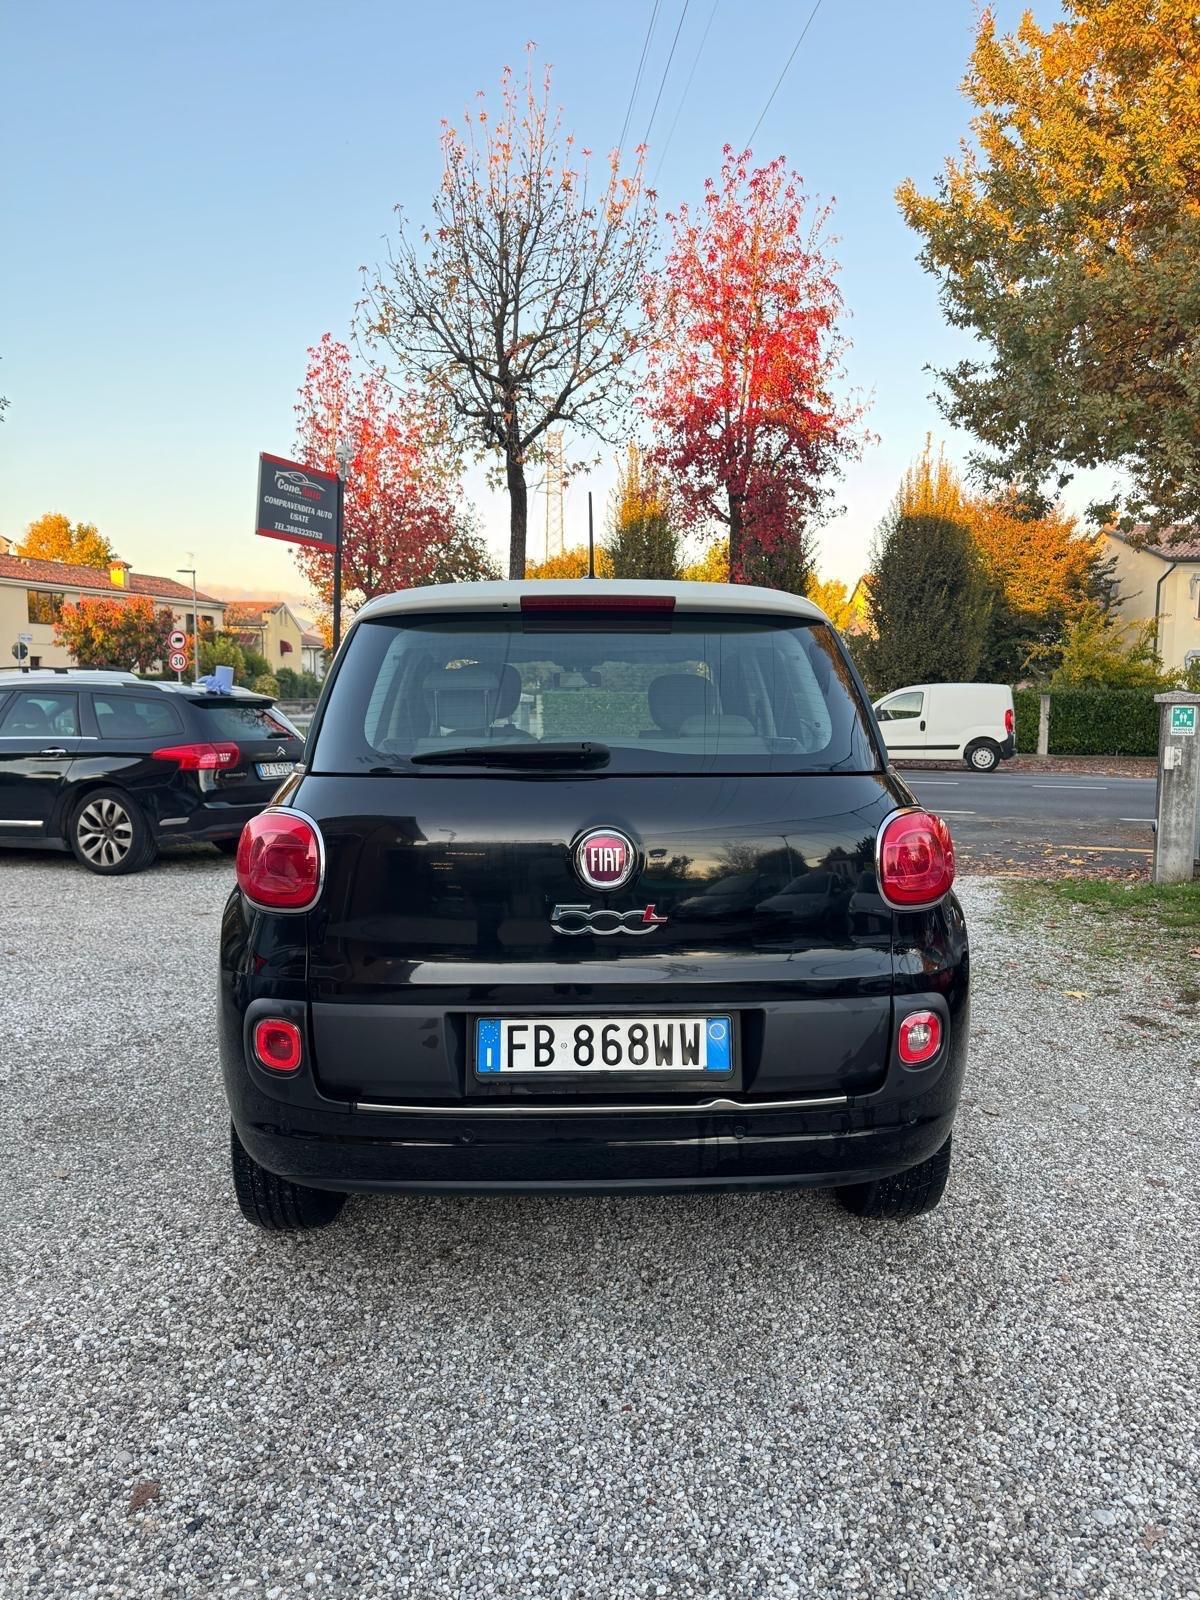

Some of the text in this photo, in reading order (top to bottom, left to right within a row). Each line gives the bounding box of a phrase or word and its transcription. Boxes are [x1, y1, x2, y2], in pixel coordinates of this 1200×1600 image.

[264, 495, 315, 515] COMPRAVENDITA
[317, 510, 332, 519] AUTO
[290, 513, 309, 523] USATE
[174, 656, 184, 666] 30
[590, 847, 622, 872] FIAT
[550, 904, 669, 935] 500L
[507, 1024, 556, 1068] FB
[573, 1022, 701, 1067] 868WW
